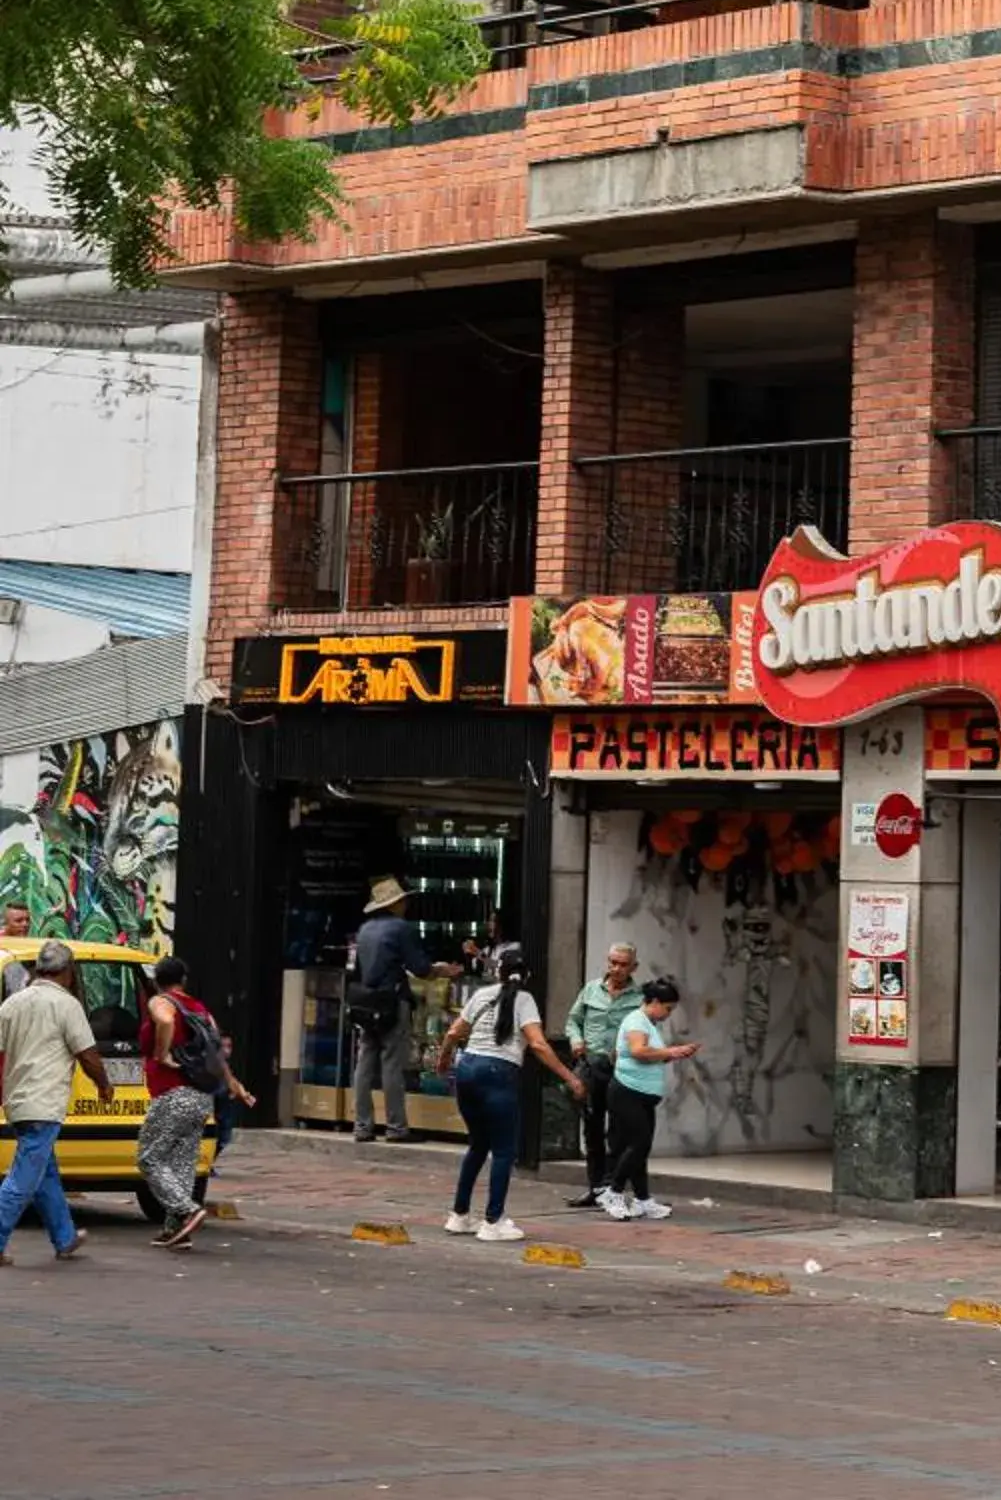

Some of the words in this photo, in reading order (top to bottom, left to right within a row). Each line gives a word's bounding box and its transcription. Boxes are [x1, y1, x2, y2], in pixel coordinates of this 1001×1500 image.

[626, 608, 650, 700] Asado
[569, 720, 820, 771] PASTELERIA
[74, 1099, 121, 1115] SERVICIO
[123, 1099, 147, 1115] PUBL
